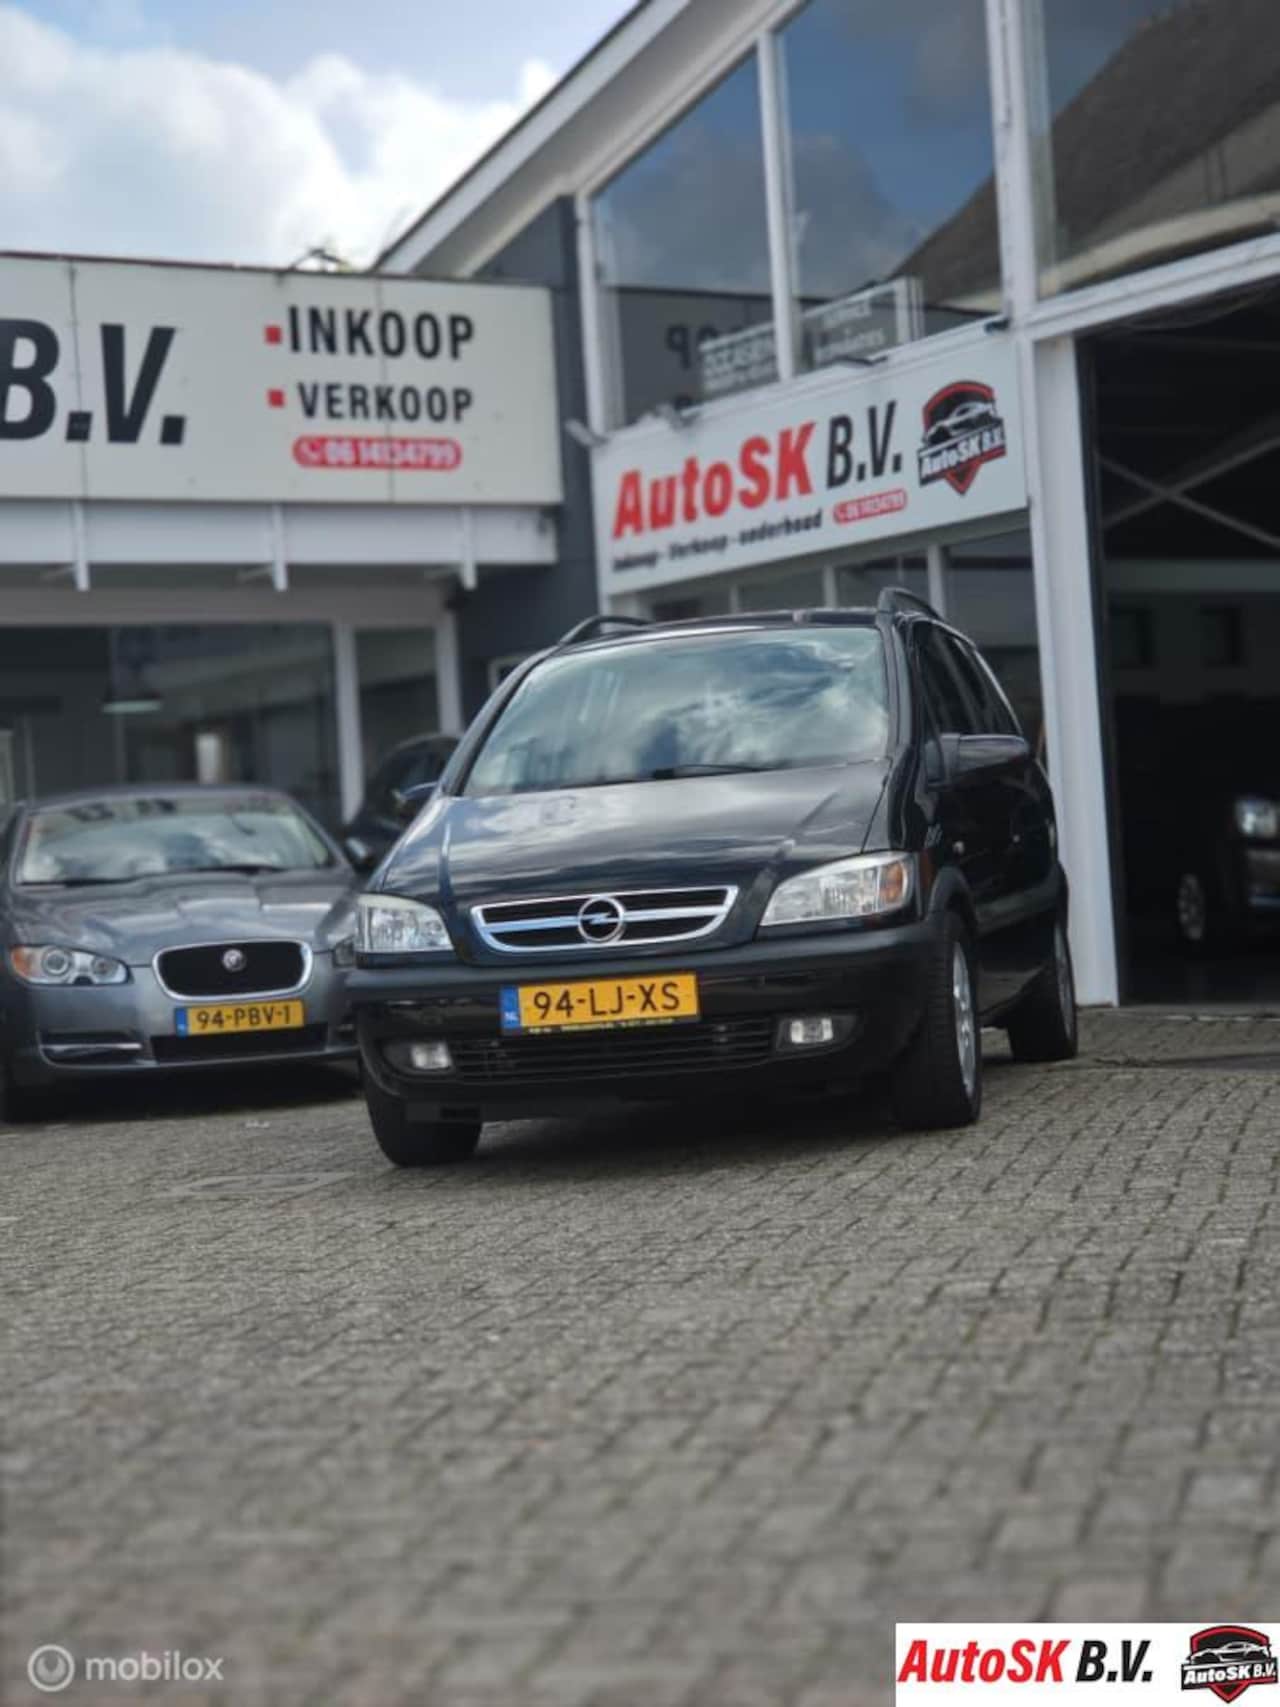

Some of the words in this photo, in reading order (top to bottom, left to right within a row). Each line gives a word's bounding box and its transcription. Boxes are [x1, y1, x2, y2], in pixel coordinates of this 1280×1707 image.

[289, 305, 474, 360] INKOOP
[0, 318, 187, 446] B.V.
[297, 381, 472, 422] VERKOOP
[612, 422, 817, 539] AutoSK
[826, 400, 903, 489] B.V.
[920, 435, 982, 478] AutoSK
[196, 1004, 292, 1030] 94-PBV-1
[533, 981, 680, 1020] 94-LJ-XS
